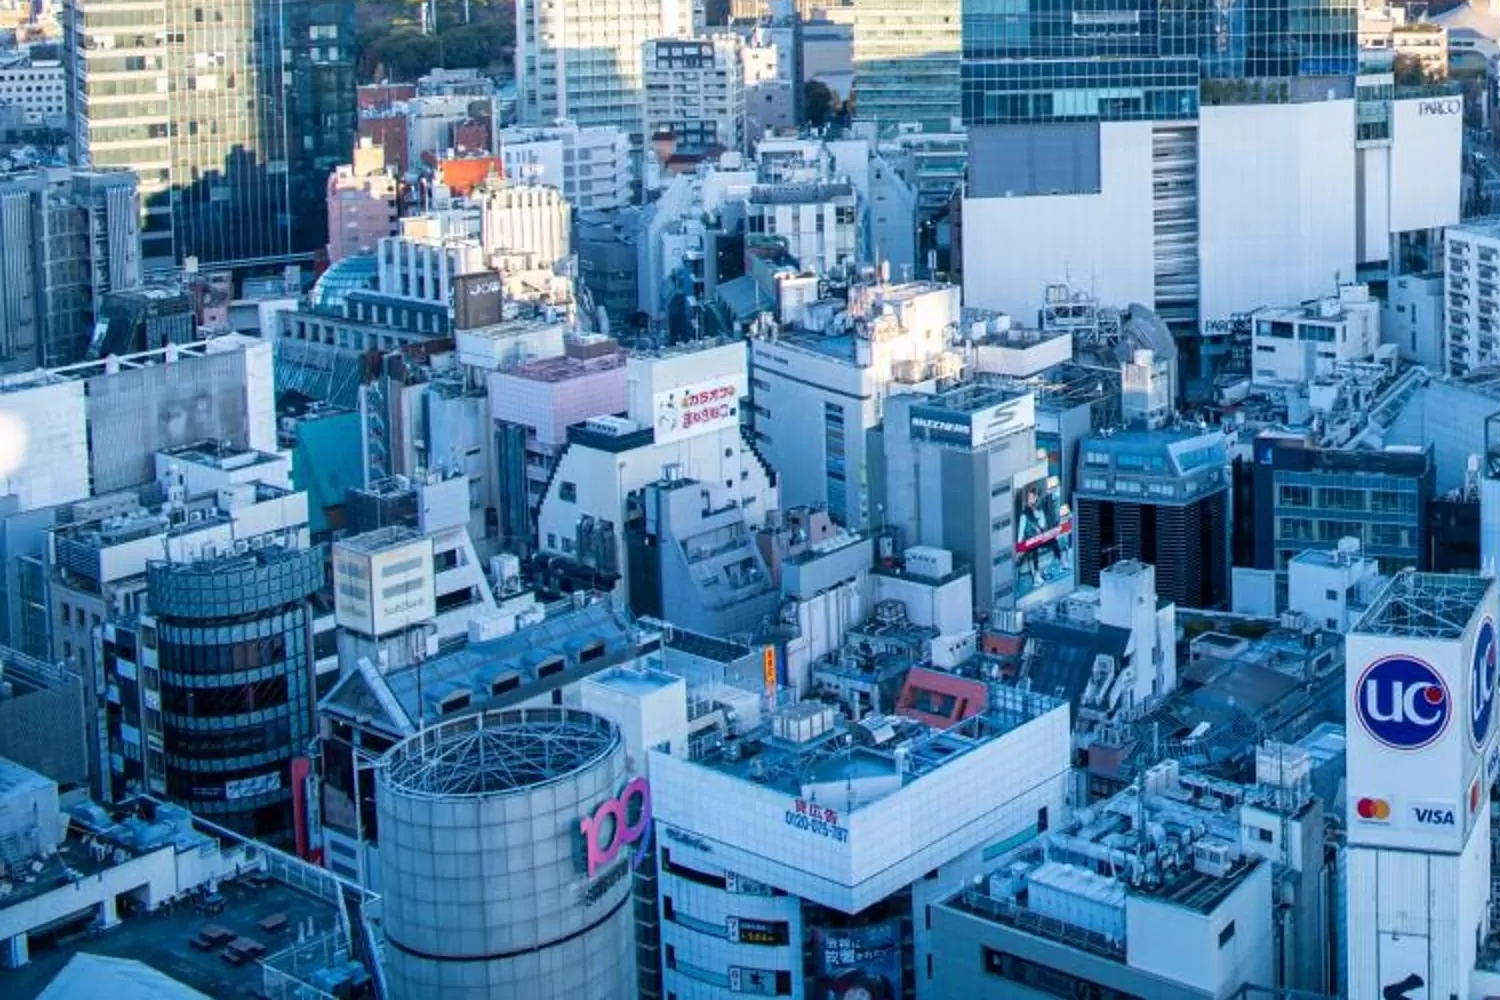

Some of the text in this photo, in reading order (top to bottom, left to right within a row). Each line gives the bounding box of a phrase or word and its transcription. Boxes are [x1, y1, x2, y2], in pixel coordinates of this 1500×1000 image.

[1418, 100, 1461, 116] PARCO
[1367, 679, 1444, 726] UC
[580, 776, 653, 879] 109
[1415, 807, 1455, 825] VISA
